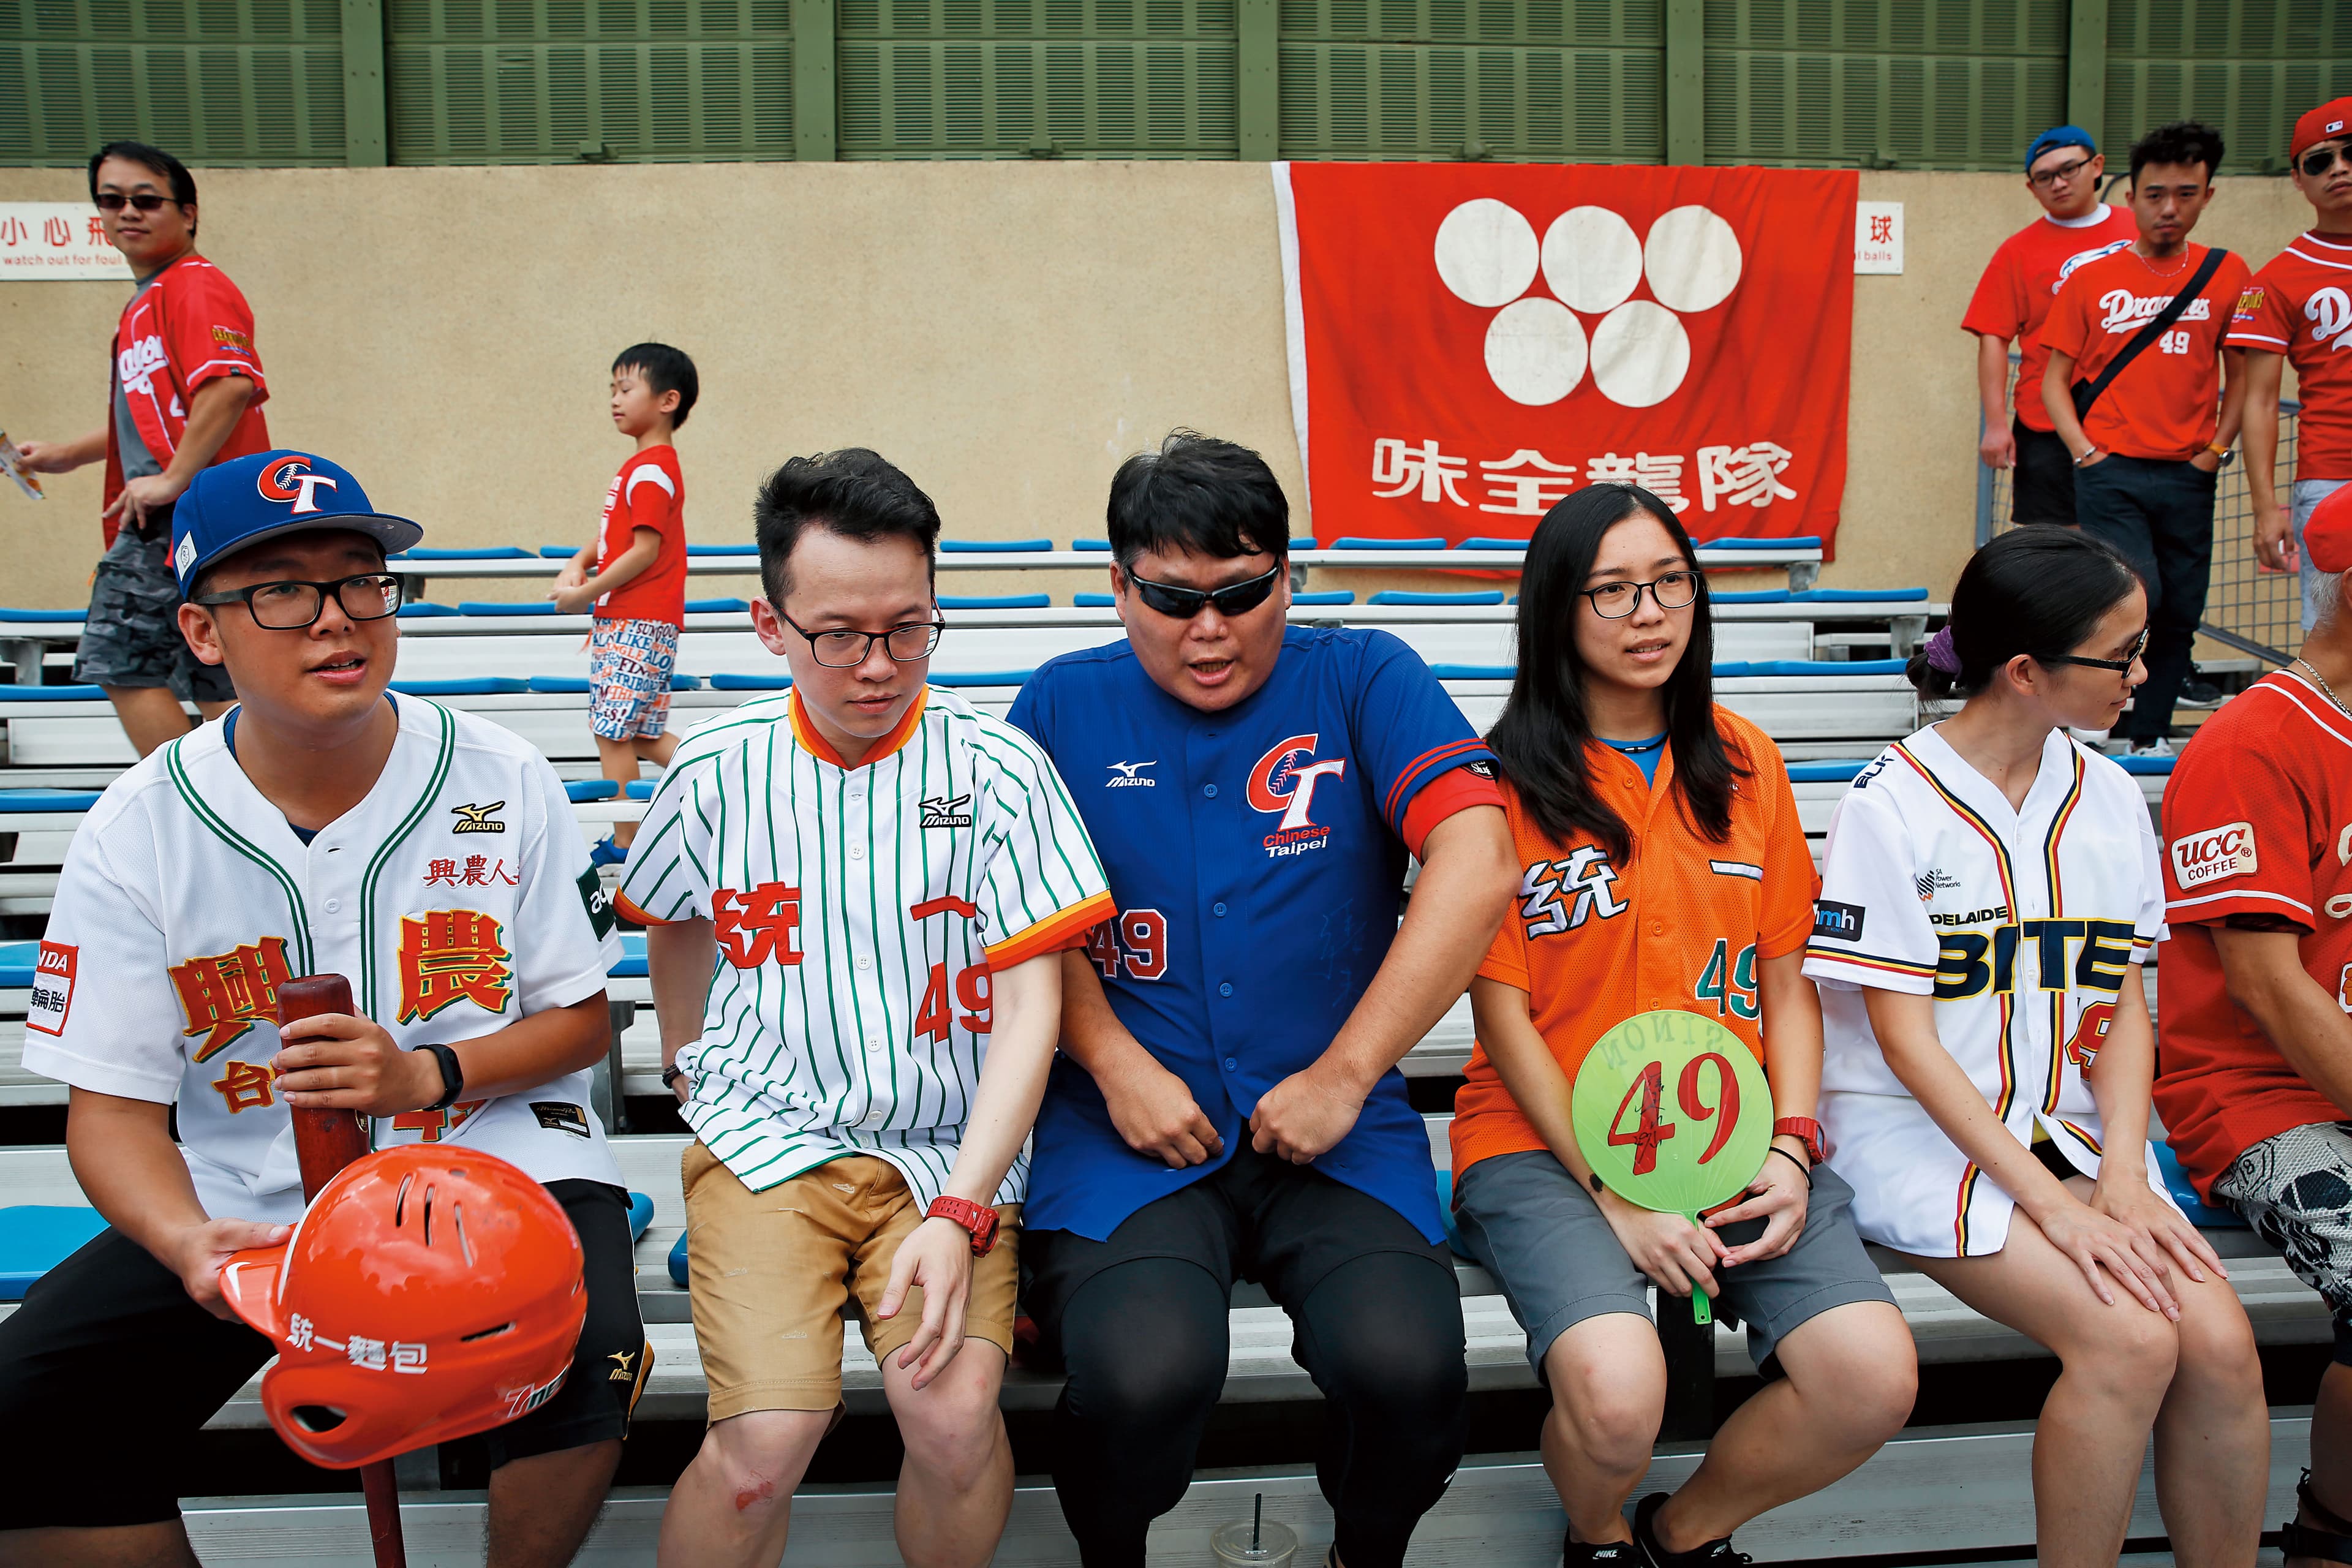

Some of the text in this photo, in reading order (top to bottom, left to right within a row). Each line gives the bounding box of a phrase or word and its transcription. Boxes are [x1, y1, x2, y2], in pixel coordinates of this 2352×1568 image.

[1870, 216, 1893, 244] 球
[4, 254, 43, 265] watch
[47, 255, 69, 265] out
[73, 254, 91, 265] for
[95, 254, 122, 265] foul
[1864, 251, 1892, 261] balls
[2159, 330, 2190, 354] 49
[616, 631, 652, 650] LIKE
[1105, 776, 1156, 788] MIZUNO
[454, 821, 503, 832] MIZUNO
[923, 814, 970, 827] MIZUNO
[1262, 826, 1331, 847] Chinese
[1265, 835, 1327, 858] Taipei
[2177, 829, 2245, 868] UCC
[423, 854, 519, 886] 興農人
[2188, 858, 2237, 881] COFFEE
[1518, 843, 1629, 941] 統
[710, 880, 804, 970] 統
[1929, 906, 2008, 925] DELAIDE
[1087, 909, 1167, 980] 49
[1932, 918, 2136, 1001] BITE
[167, 909, 513, 1063] 興 農
[1695, 938, 1760, 1020] 49
[31, 987, 65, 1013] 輪胎
[915, 962, 993, 1043] 49
[210, 1060, 285, 1114] 台
[1607, 1052, 1740, 1176] 49
[285, 1312, 428, 1374] 統一麵包
[1596, 1549, 1619, 1558] NIKE
